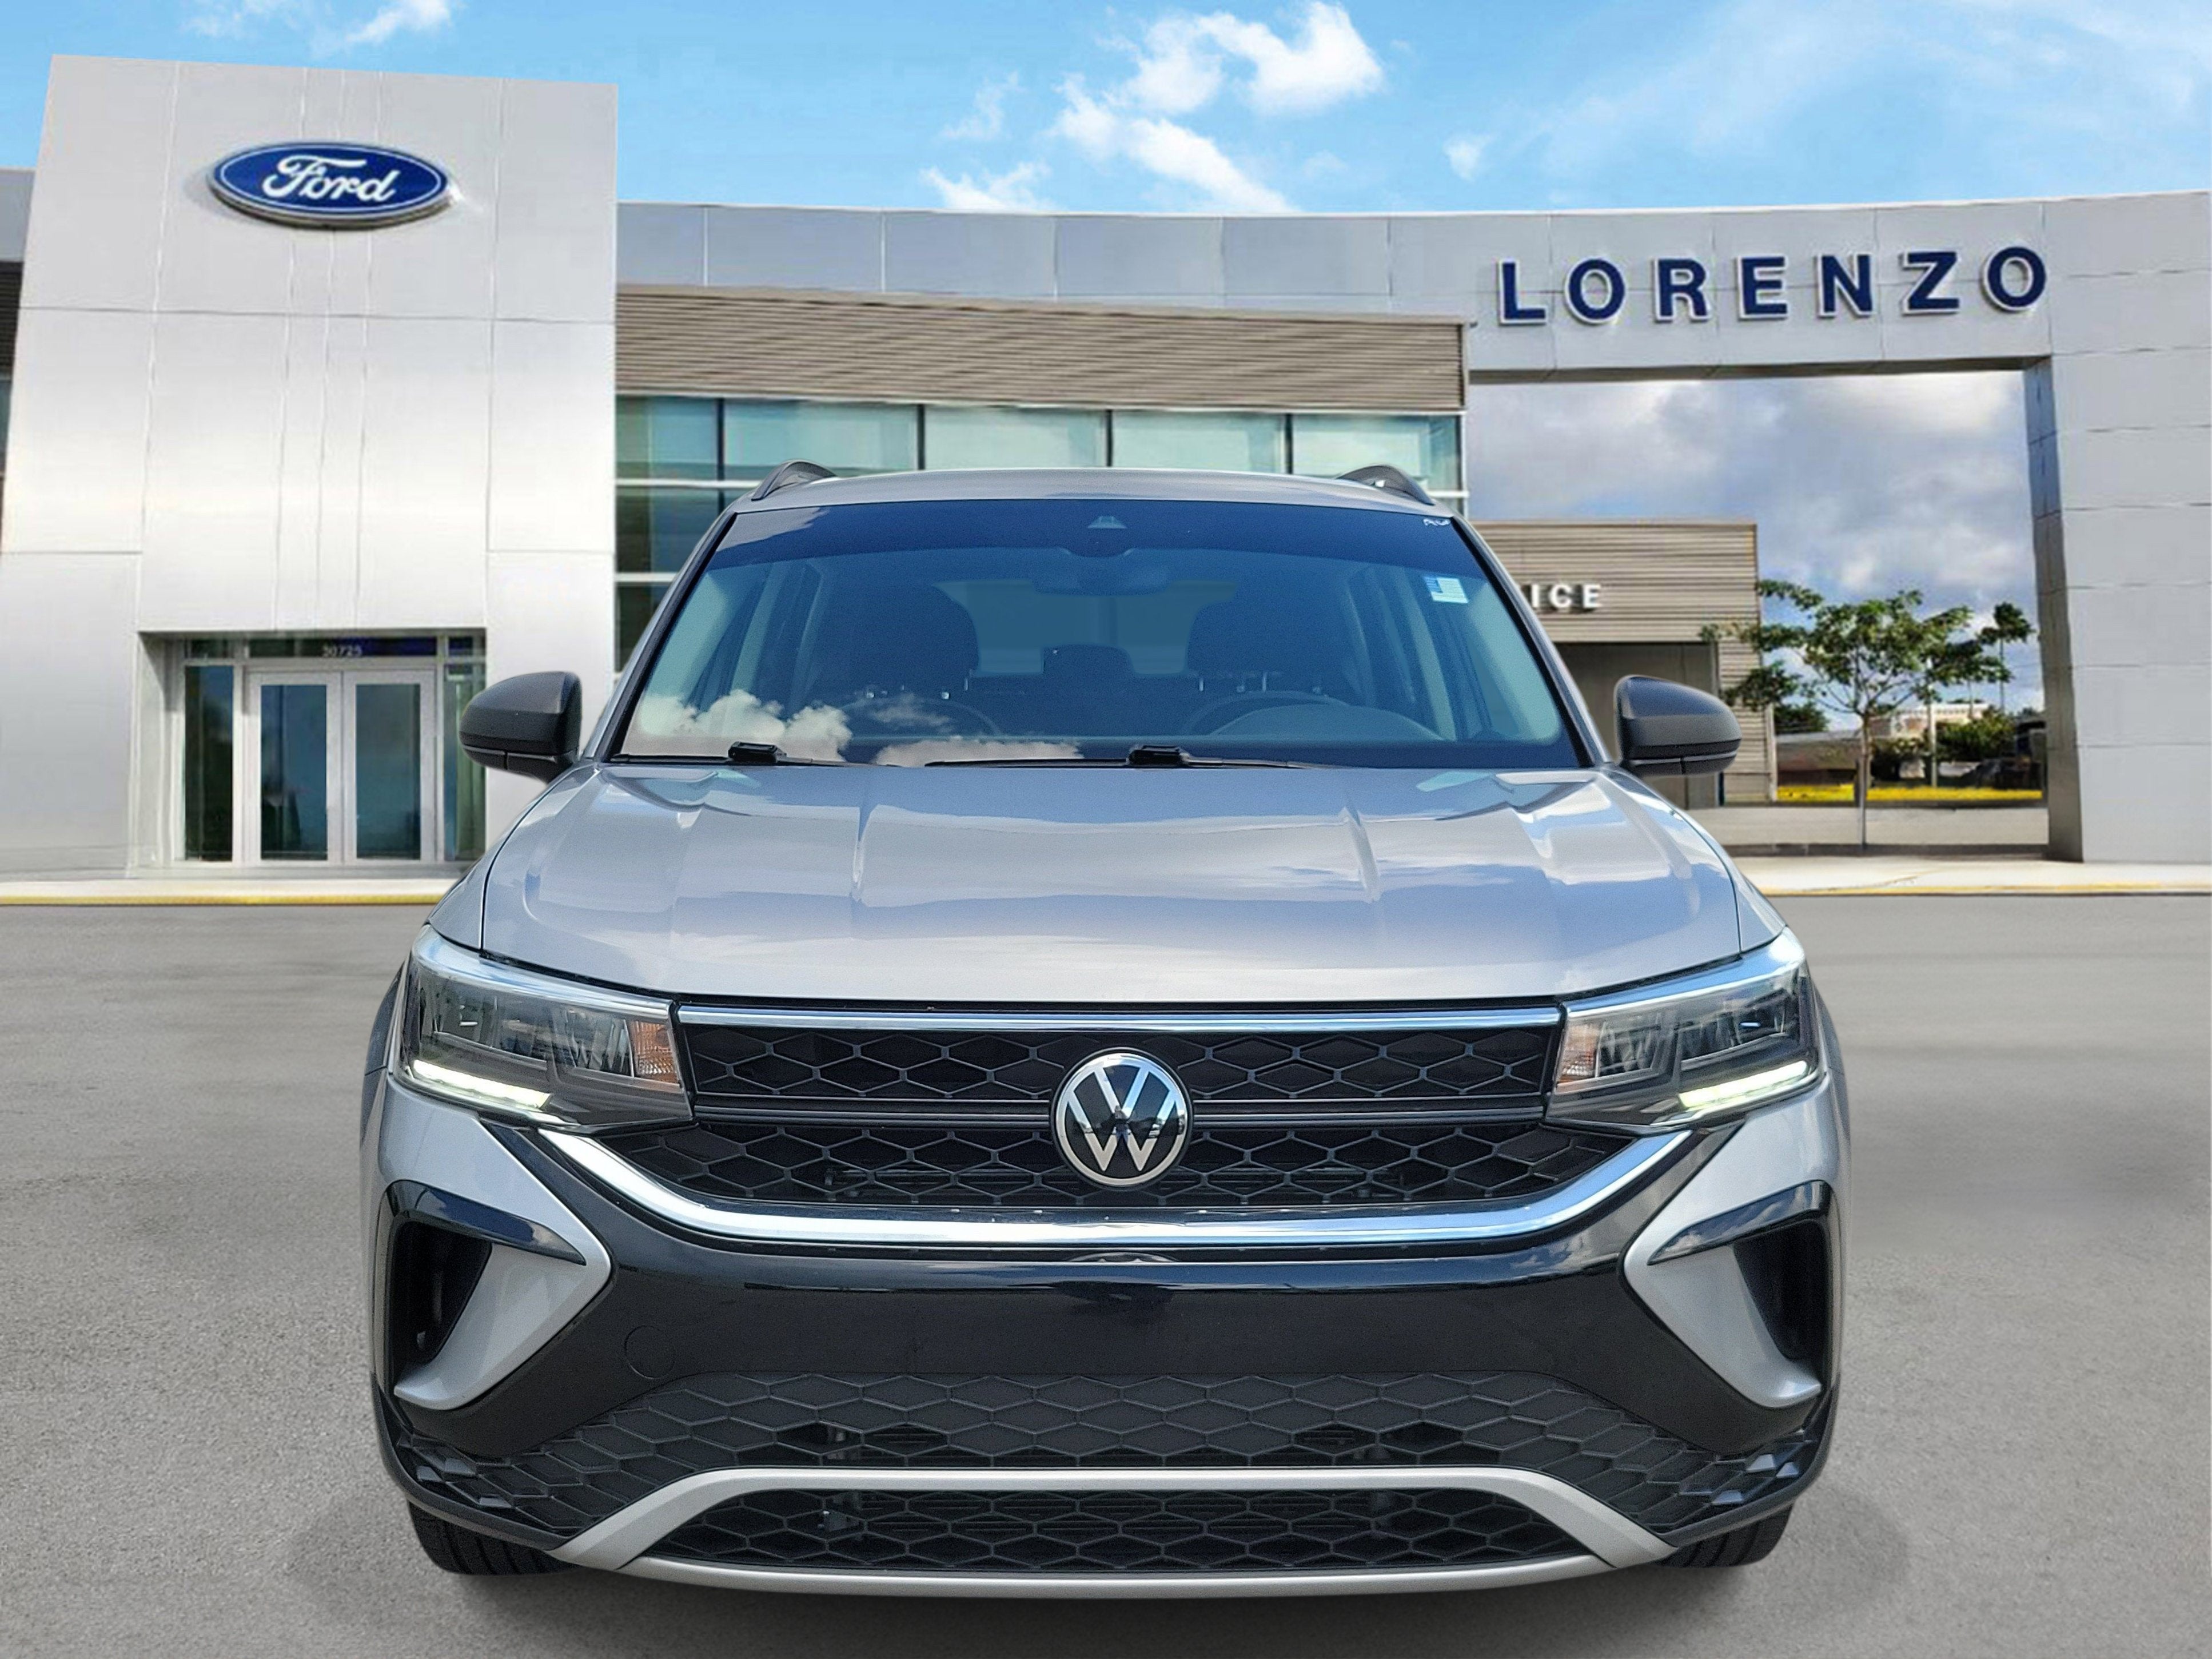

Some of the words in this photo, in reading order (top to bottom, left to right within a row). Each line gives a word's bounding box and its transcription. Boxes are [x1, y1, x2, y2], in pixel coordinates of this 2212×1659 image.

[262, 154, 400, 201] Ford
[1497, 246, 2047, 324] LORENZO
[1529, 583, 1602, 609] ICE
